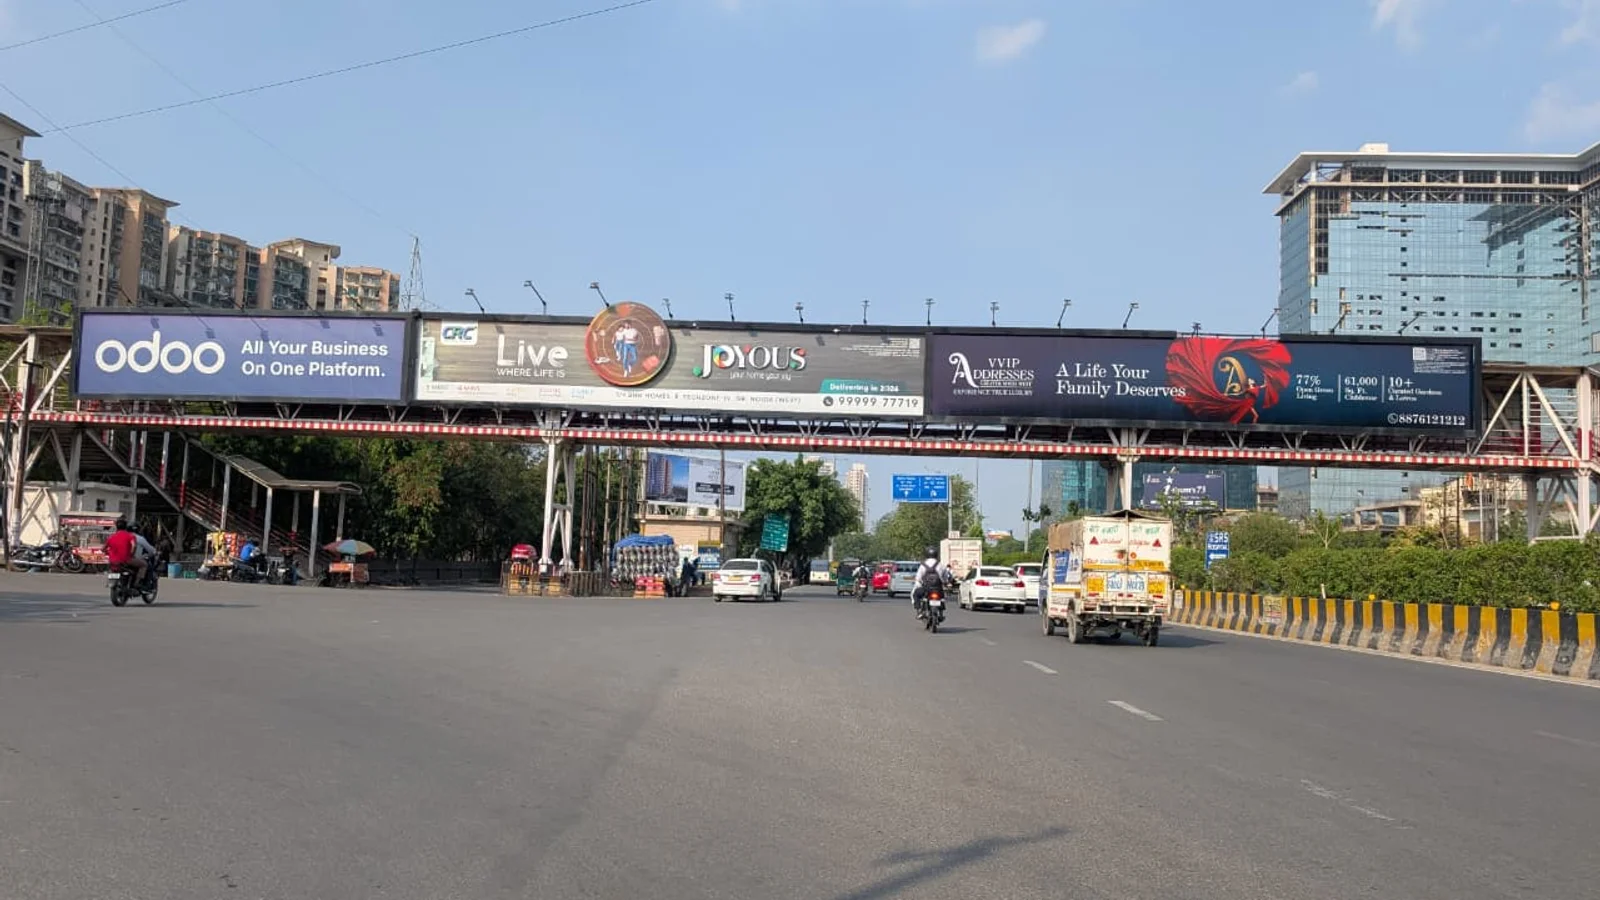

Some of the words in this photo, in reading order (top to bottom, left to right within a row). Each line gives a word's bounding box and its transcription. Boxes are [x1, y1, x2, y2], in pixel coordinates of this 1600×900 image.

[442, 326, 477, 340] CRC
[95, 330, 225, 374] odoo
[241, 340, 263, 354] All
[269, 341, 306, 356] Your
[311, 341, 388, 357] Business
[497, 334, 568, 367] Live
[693, 344, 806, 379] JOYOUS
[988, 358, 1021, 368] VVIP
[242, 361, 265, 376] On
[270, 361, 304, 377] One
[309, 361, 386, 377] Platform.
[497, 368, 531, 377] WHERE
[534, 368, 554, 378] LIFE
[556, 369, 565, 378] IS
[949, 352, 1034, 388] ADDRESSES
[1055, 362, 1070, 377] A
[1076, 363, 1107, 378] Life
[1111, 364, 1150, 379] Your
[1296, 374, 1321, 386] 77%
[1344, 376, 1378, 387] 61,000
[1388, 377, 1415, 388] 10+
[830, 383, 869, 392] Delivering
[1056, 380, 1111, 398] Family
[1116, 381, 1186, 397] Deserves
[839, 396, 877, 406] 99999
[883, 397, 918, 407] 77719
[1399, 413, 1466, 425] 8876121212
